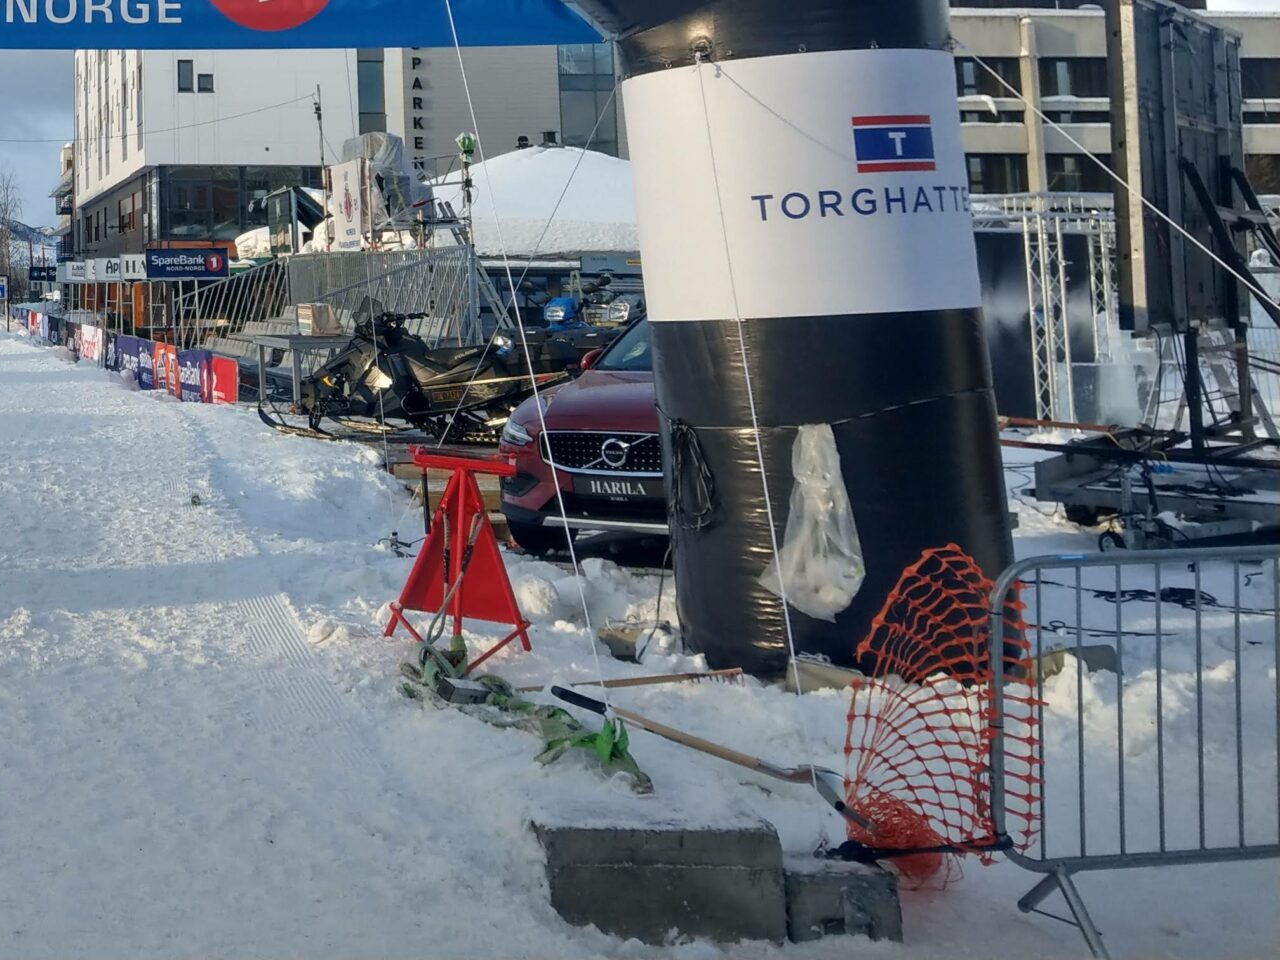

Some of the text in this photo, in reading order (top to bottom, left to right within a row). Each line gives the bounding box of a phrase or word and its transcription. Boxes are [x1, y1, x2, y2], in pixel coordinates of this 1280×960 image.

[411, 48, 425, 170] PARKEN
[751, 186, 969, 221] TORGHATTE
[151, 255, 205, 266] SpareBank
[590, 480, 647, 496] HARILA
